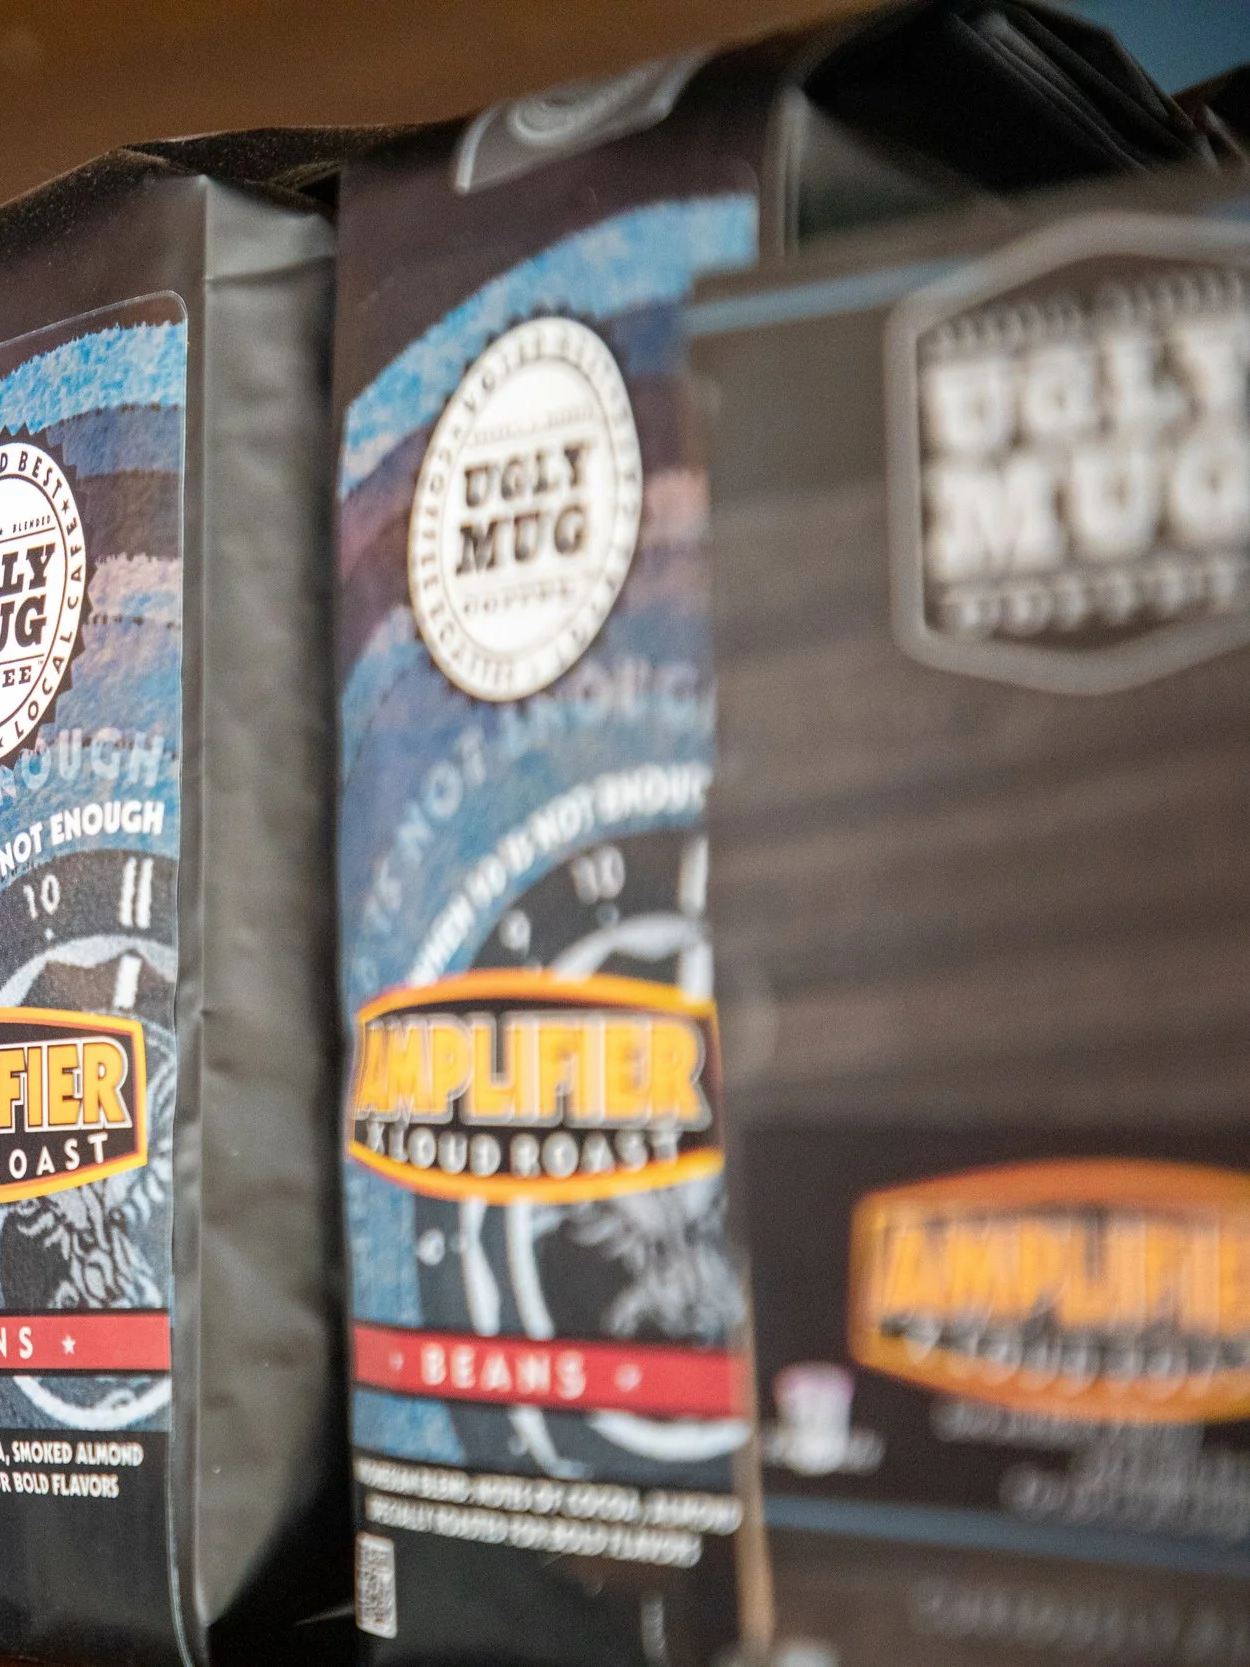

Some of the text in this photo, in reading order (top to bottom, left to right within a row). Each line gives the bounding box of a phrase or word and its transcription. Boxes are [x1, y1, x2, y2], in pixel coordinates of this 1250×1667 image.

[18, 450, 63, 501] BEST
[463, 440, 590, 509] UGLY
[12, 514, 52, 533] BLENDED
[453, 503, 588, 576] MUG
[14, 516, 82, 741] LOCAL CAFE
[50, 800, 166, 838] ENOUGH
[22, 873, 61, 920] 10
[348, 1011, 714, 1132] AMPLIFIER
[509, 1118, 684, 1179] ROAST
[420, 1341, 587, 1401] BEANS
[11, 1440, 73, 1466] SMOKED
[75, 1441, 145, 1468] ALMOND
[12, 1471, 50, 1496] BOLD
[51, 1473, 120, 1499] FLAVORS
